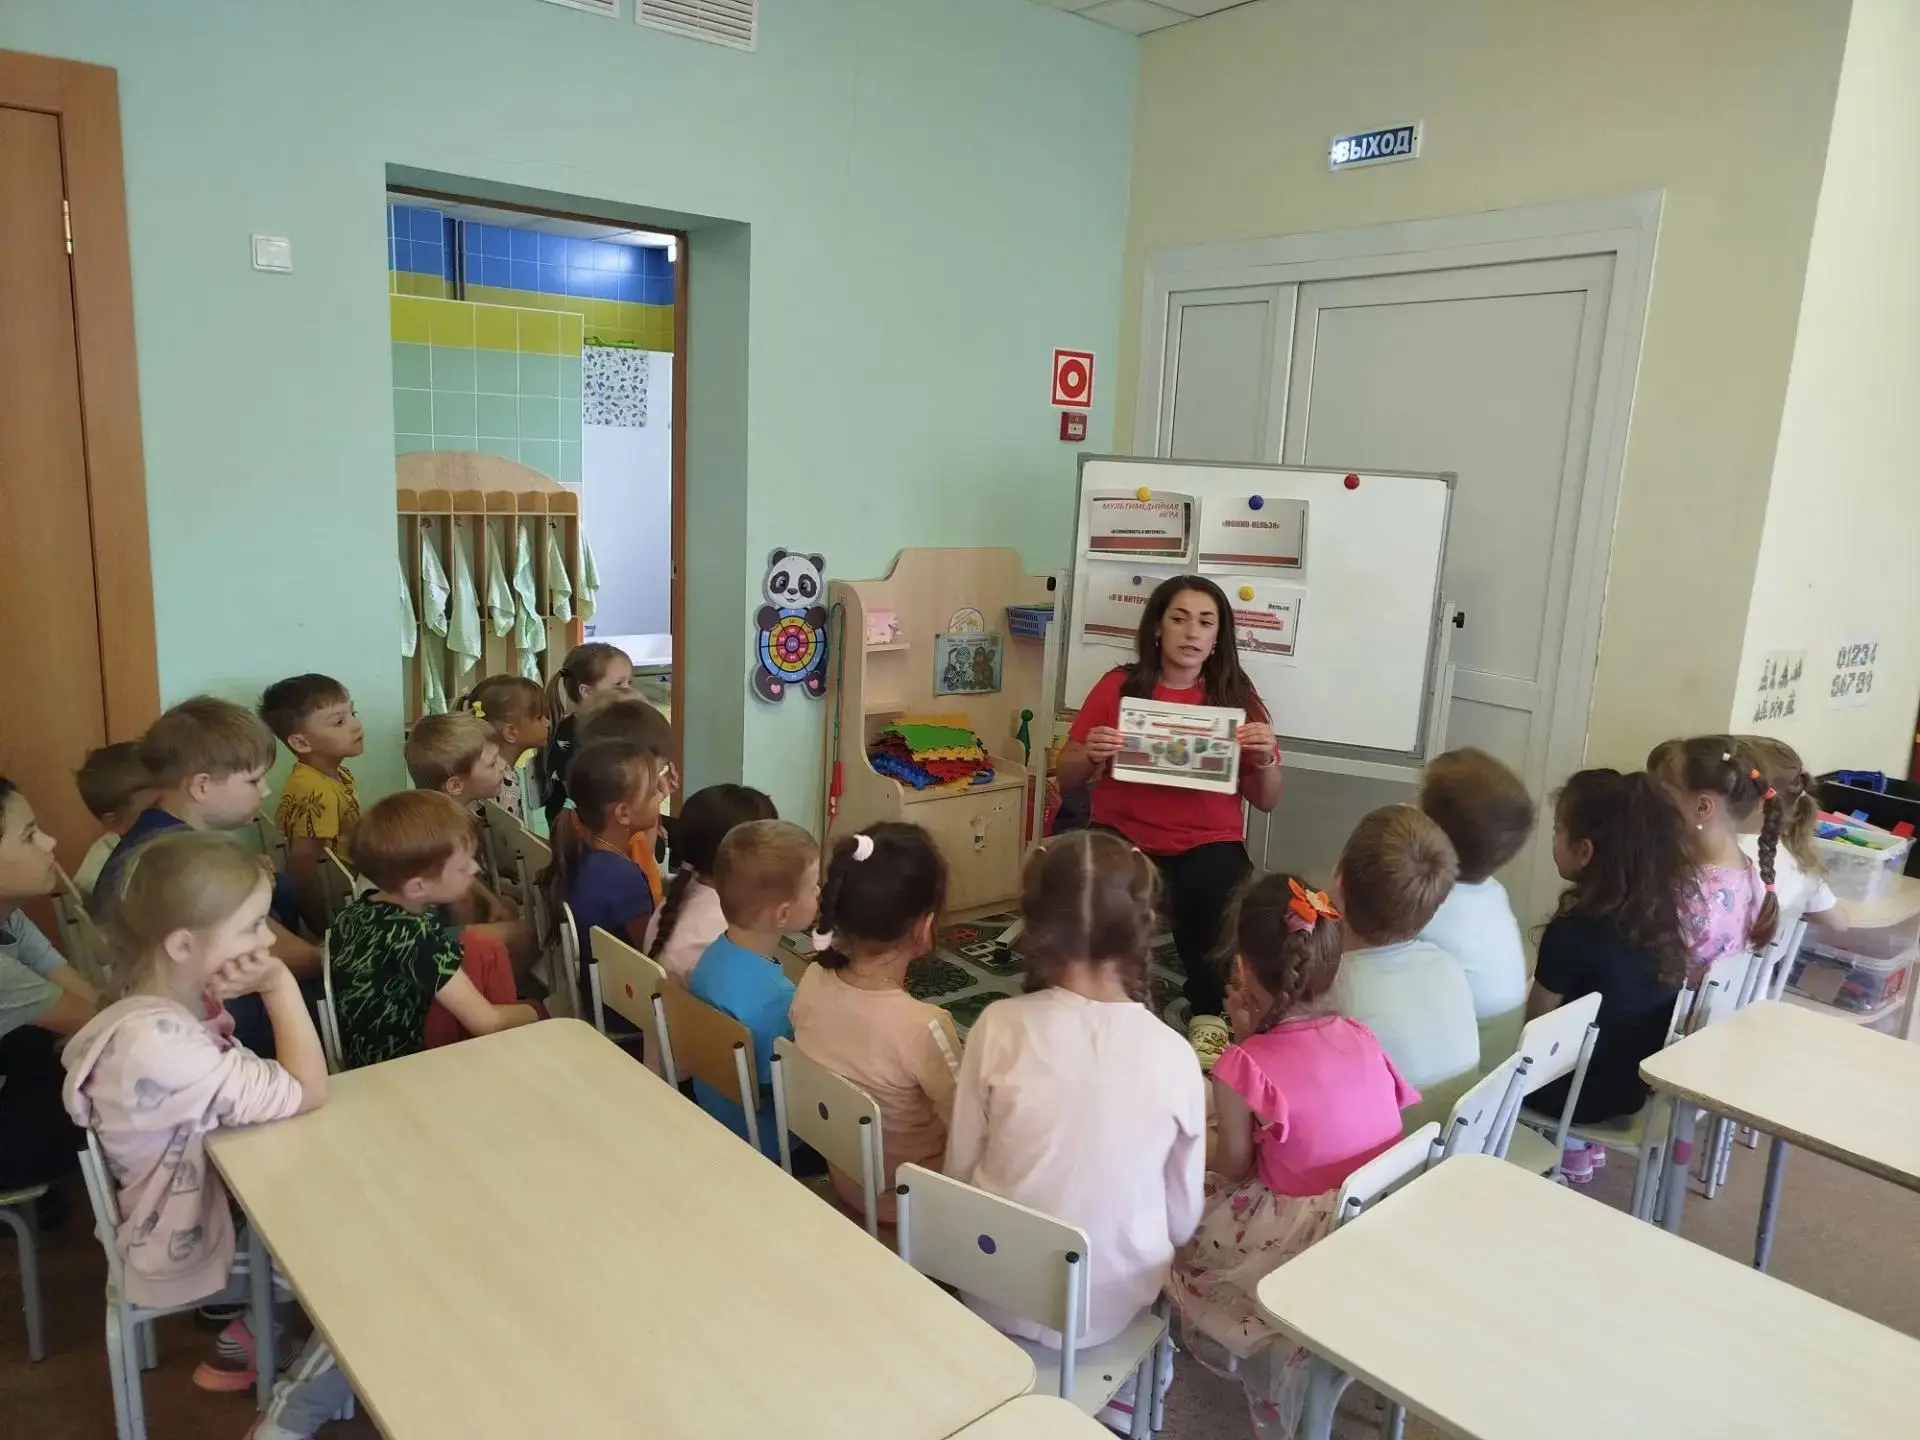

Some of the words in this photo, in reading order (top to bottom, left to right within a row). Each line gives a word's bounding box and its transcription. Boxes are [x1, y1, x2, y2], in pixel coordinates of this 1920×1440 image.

[1334, 129, 1411, 163] ВЫХОД
[1102, 502, 1180, 511] МУЛЬТИМЕДИЙНАЯ
[1159, 511, 1179, 519] ИГРА
